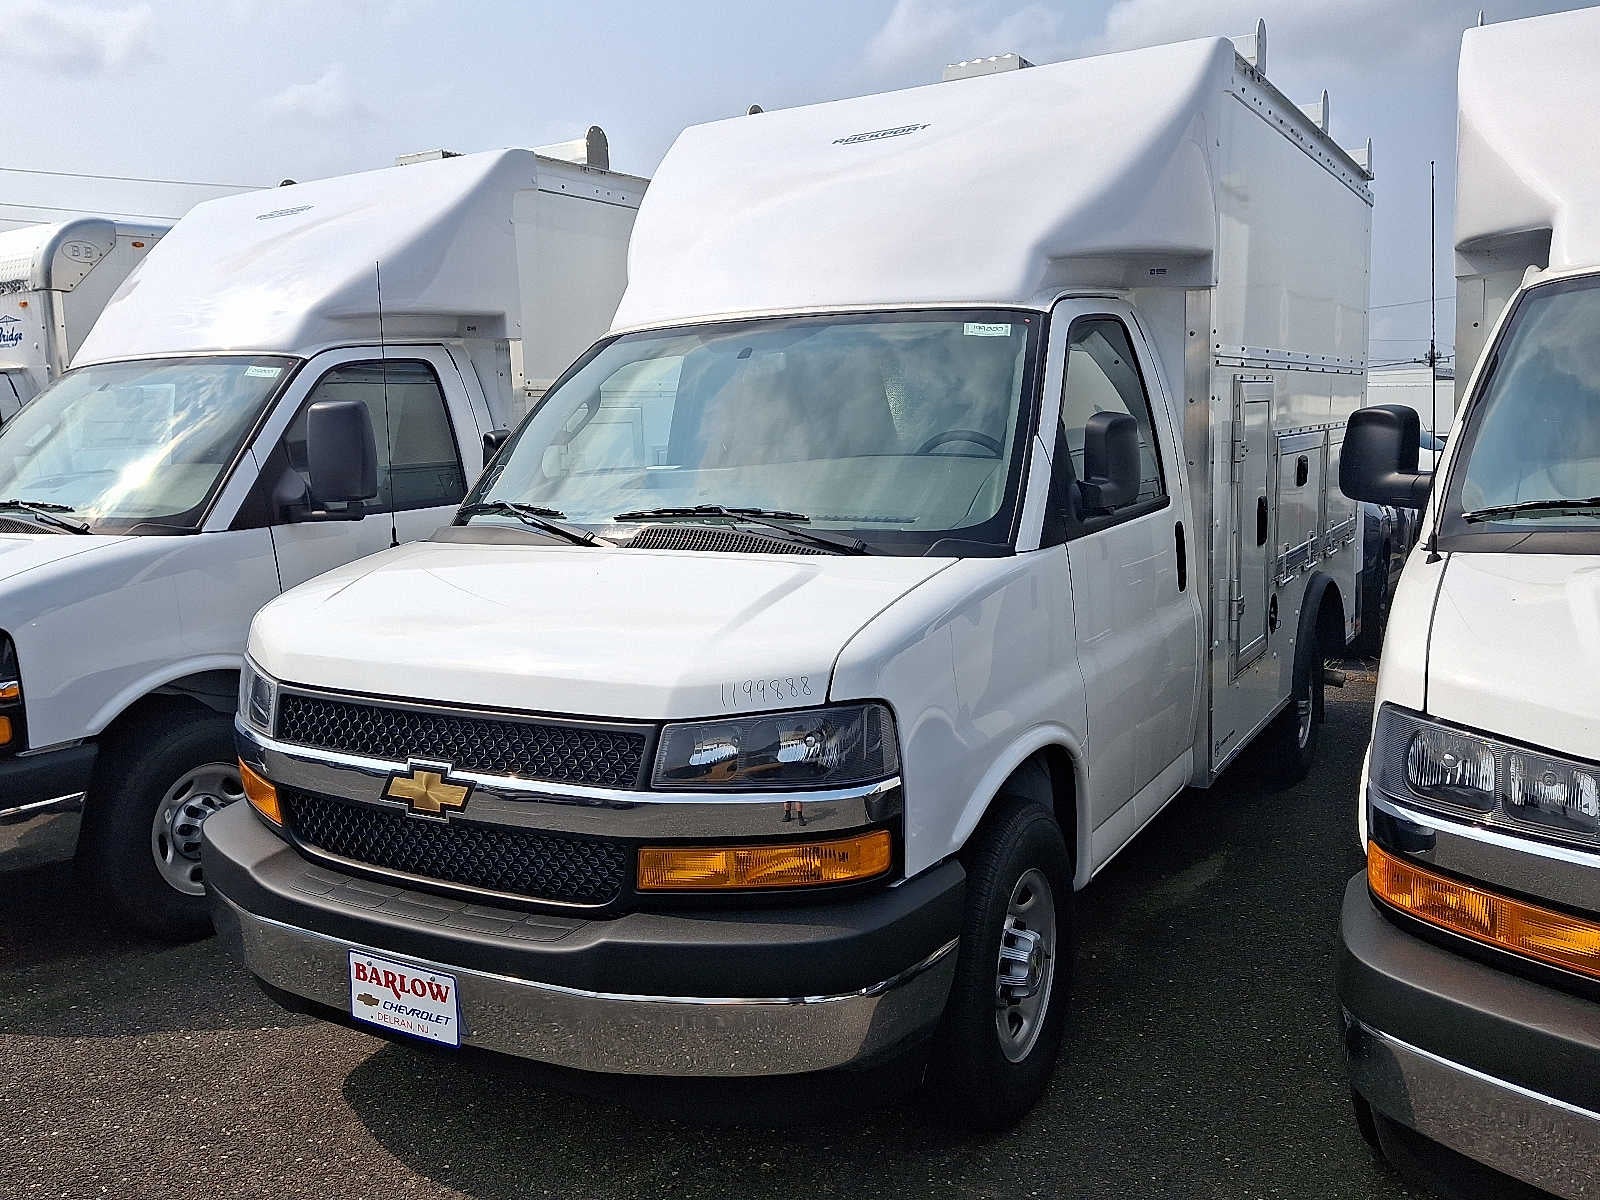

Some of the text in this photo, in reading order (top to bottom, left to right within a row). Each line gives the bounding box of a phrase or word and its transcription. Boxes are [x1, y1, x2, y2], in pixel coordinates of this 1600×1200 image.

[832, 123, 931, 145] ROCKPORT
[721, 676, 812, 707] 1199888
[353, 961, 450, 1004] BARLOW
[382, 1000, 453, 1026] CHEVROLET
[417, 1023, 430, 1034] NJ
